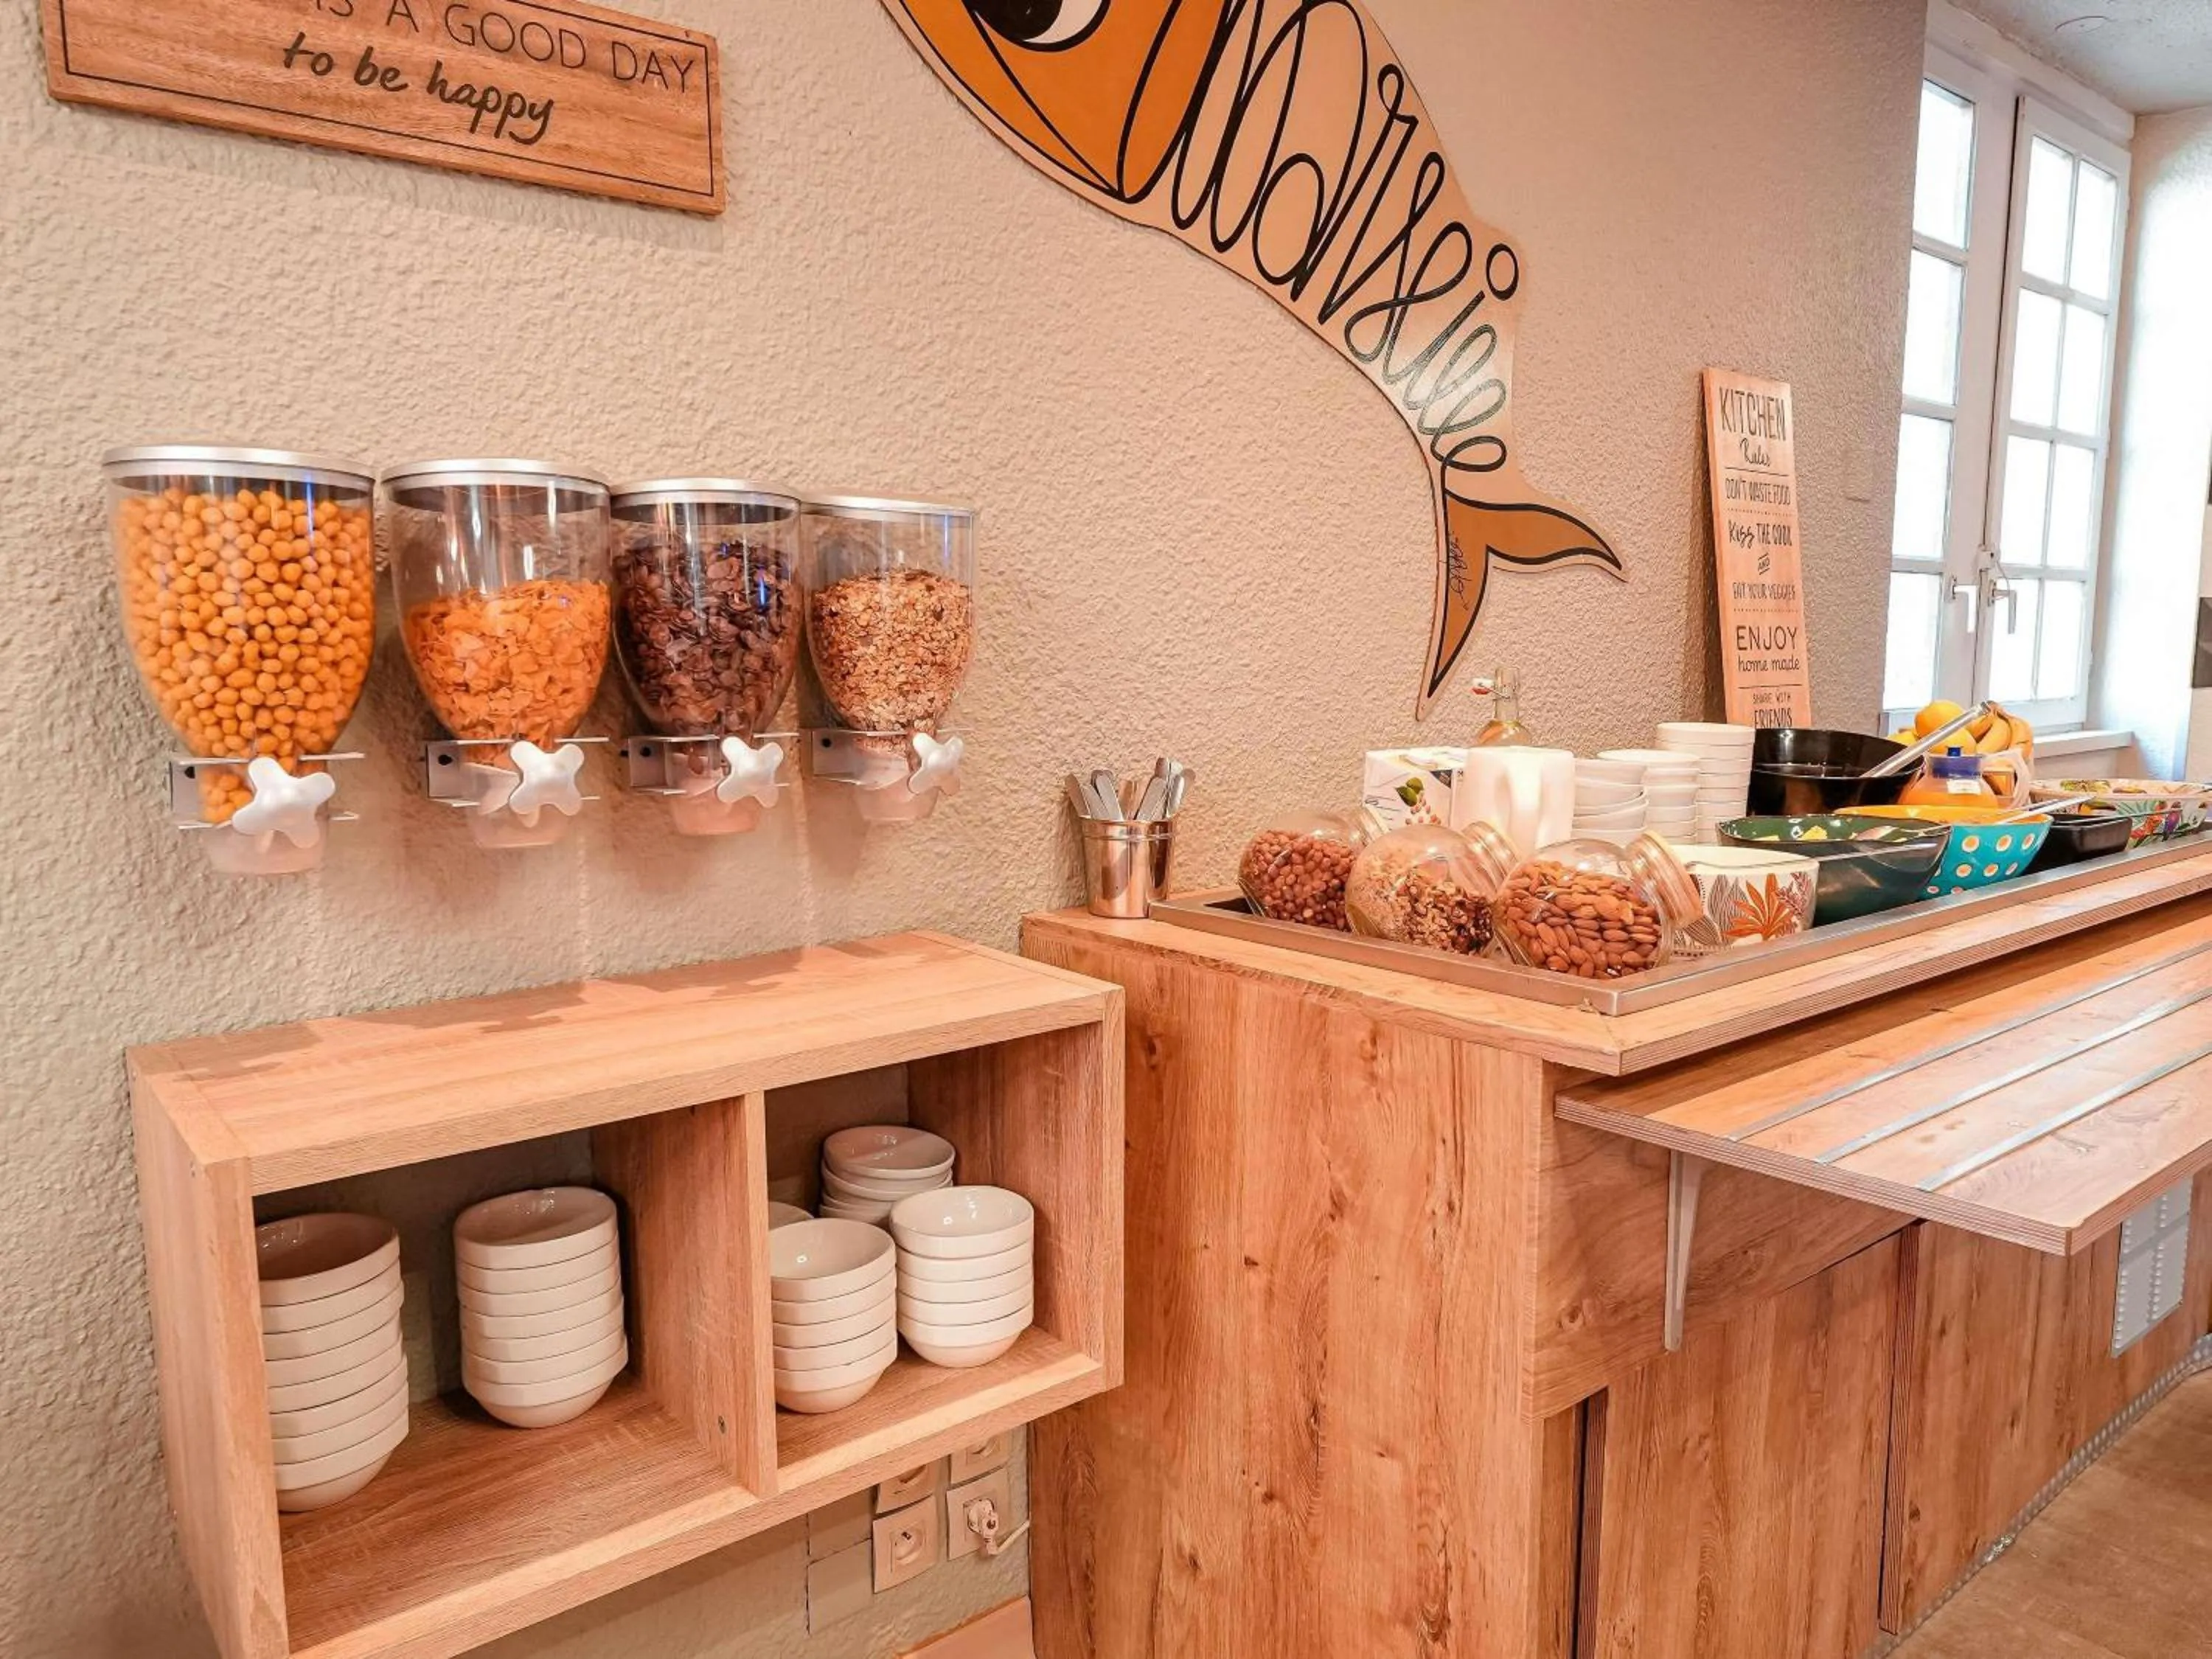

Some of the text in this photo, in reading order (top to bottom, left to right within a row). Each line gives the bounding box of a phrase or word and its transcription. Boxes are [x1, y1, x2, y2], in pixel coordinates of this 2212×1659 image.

[386, 0, 695, 93] A GOOD DAY
[282, 32, 555, 145] to be happy
[1719, 387, 1787, 441] KITCHEN
[1748, 481, 1772, 504] WASTE
[1773, 484, 1791, 505] FOOD
[1756, 523, 1771, 545] THE
[1772, 524, 1792, 546] COOK
[1733, 582, 1746, 599] EAT
[1747, 583, 1767, 599] YOUR
[1736, 625, 1798, 650] ENJOY
[1738, 654, 1800, 672] home made
[1754, 707, 1793, 729] FRIENDS
